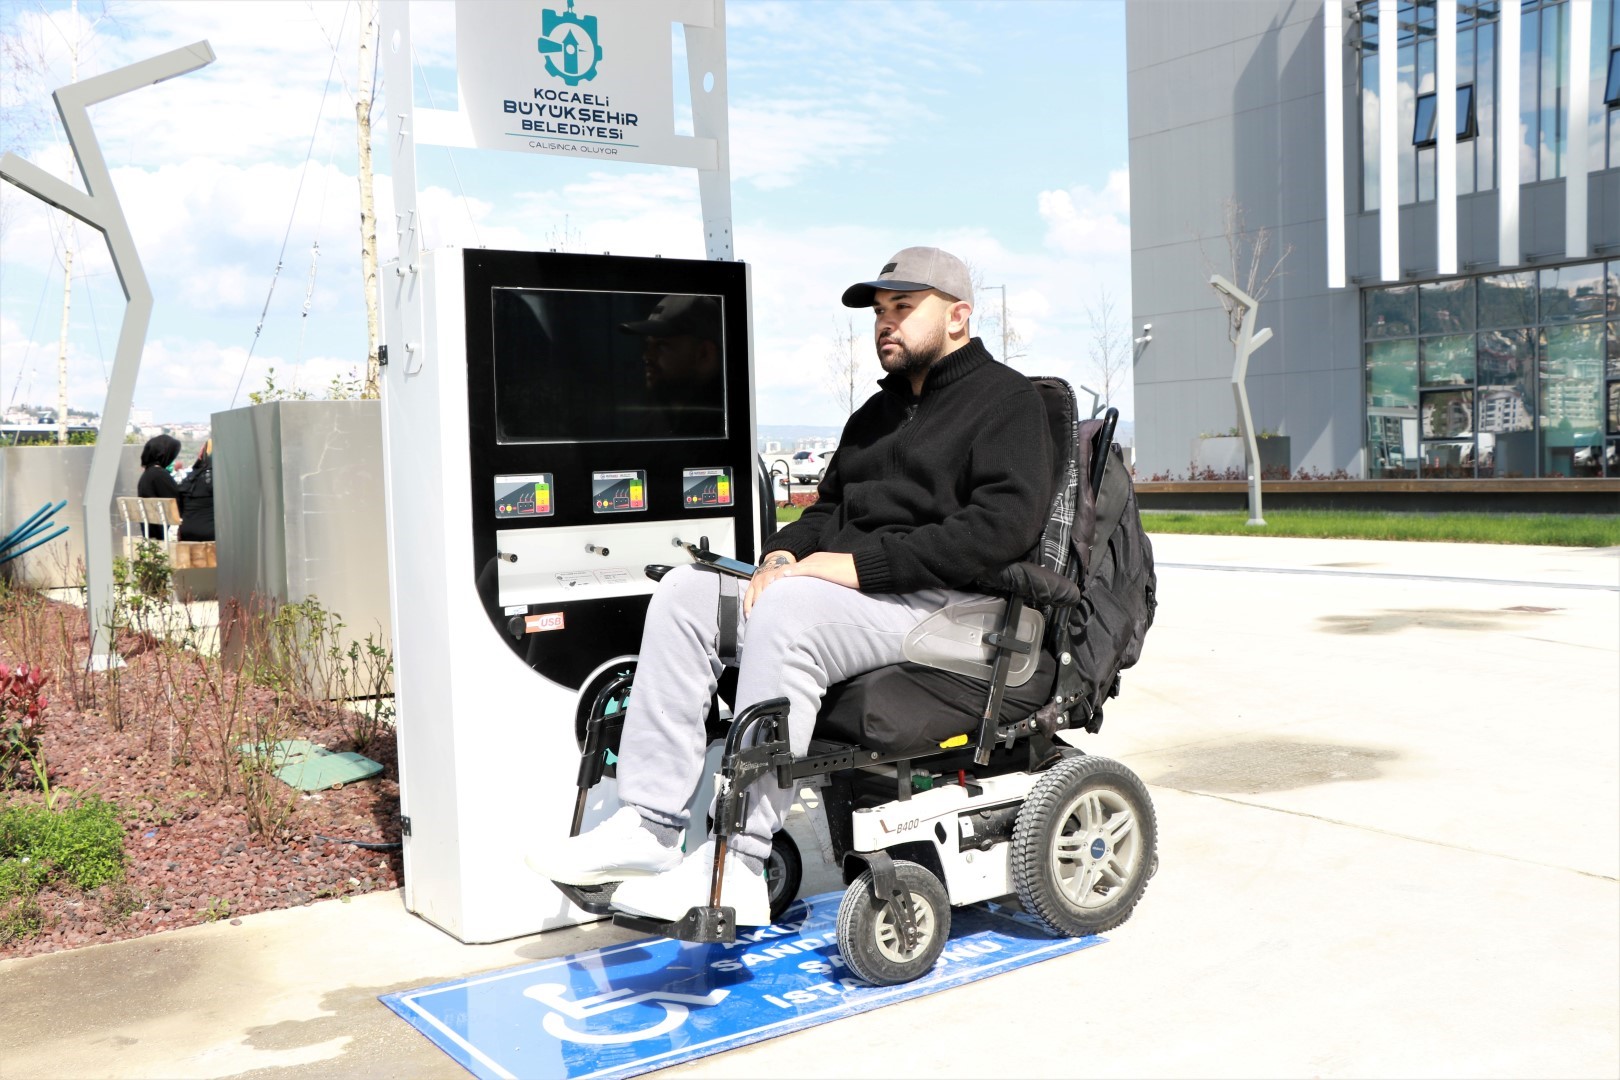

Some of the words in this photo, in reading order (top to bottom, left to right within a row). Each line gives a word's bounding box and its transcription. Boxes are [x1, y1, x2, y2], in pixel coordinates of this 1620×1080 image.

[580, 145, 618, 155] OLUYOR
[540, 616, 563, 627] USB
[896, 818, 919, 834] B400
